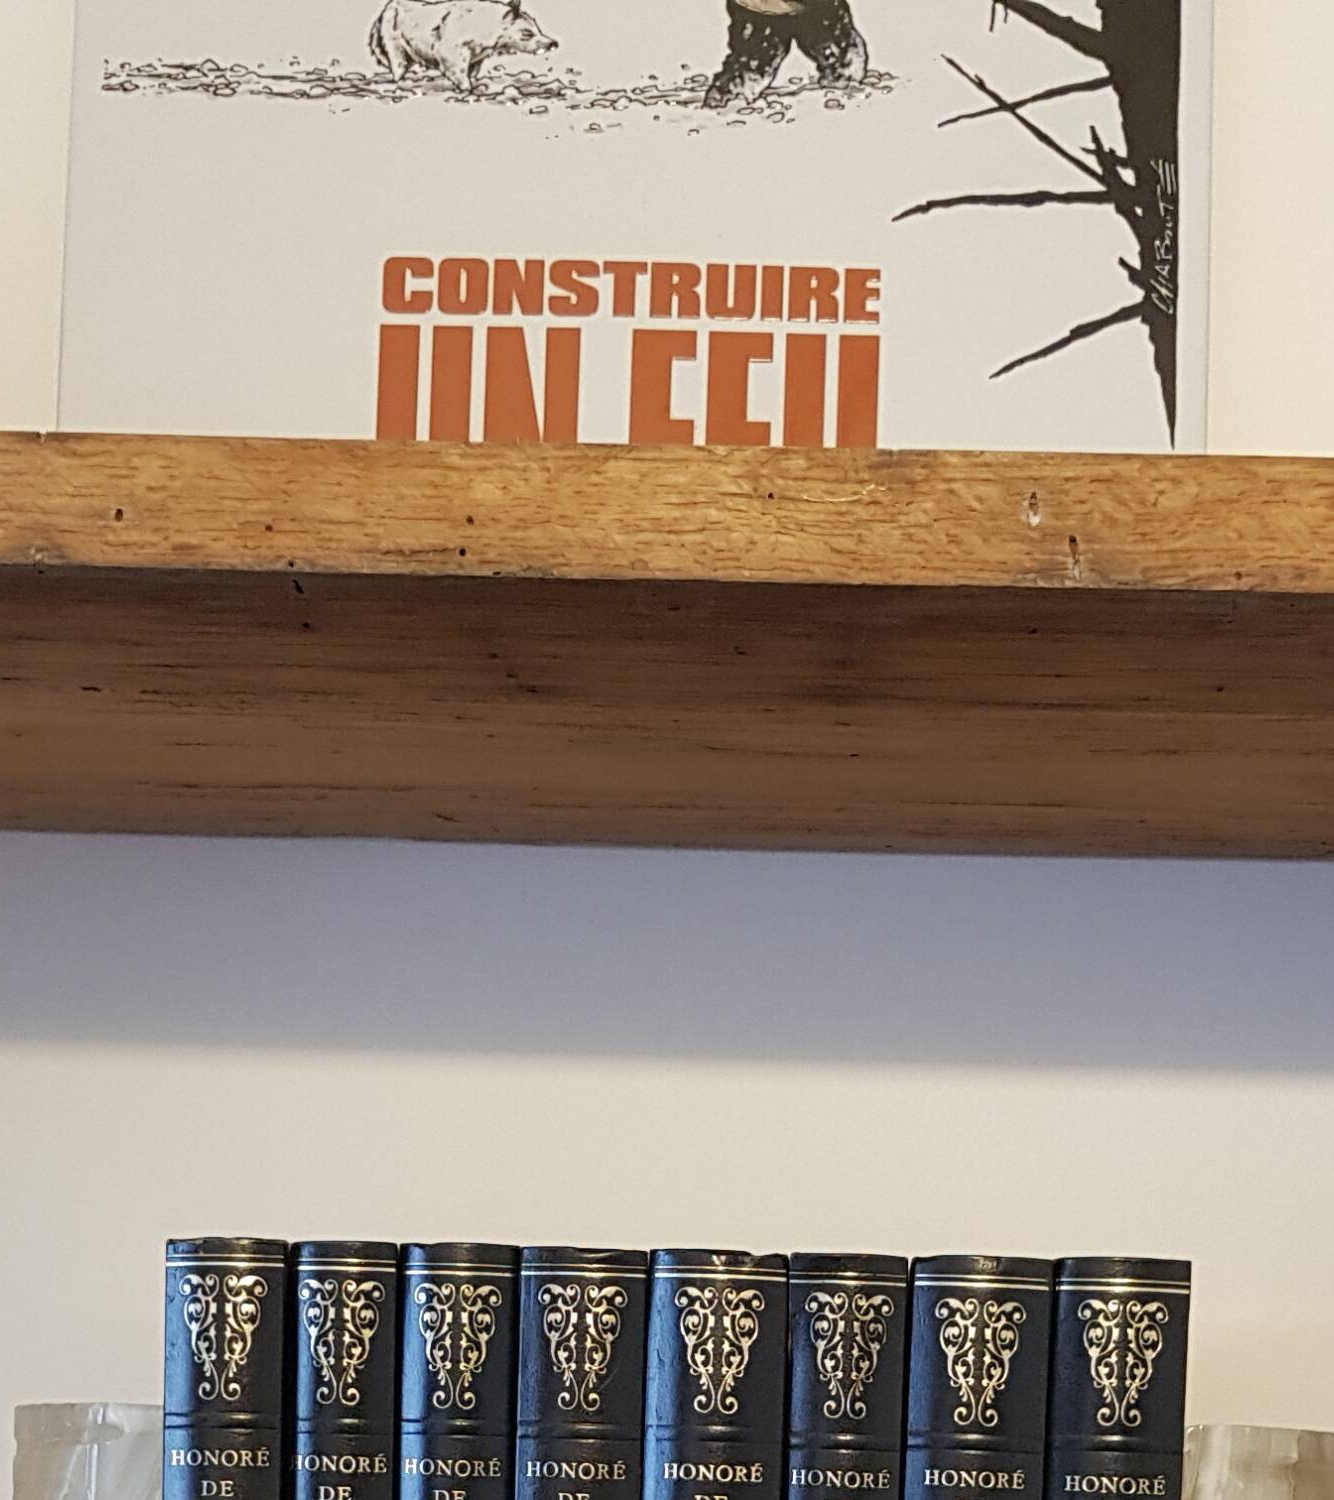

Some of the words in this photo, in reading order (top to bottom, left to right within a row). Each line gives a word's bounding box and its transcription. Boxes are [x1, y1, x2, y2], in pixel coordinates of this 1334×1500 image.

[382, 256, 882, 325] CONSTRUIRE
[170, 1446, 270, 1467] HONORÉ
[291, 1453, 387, 1473] HONORÉ
[404, 1457, 501, 1477] HONORÉ
[526, 1460, 626, 1480] HONORÉ
[663, 1462, 764, 1483] HONORÉ
[201, 1480, 234, 1497] DE
[791, 1469, 891, 1489] HONORÉ
[924, 1469, 1025, 1490] HONORÉ
[1064, 1475, 1165, 1496] HONORÉ
